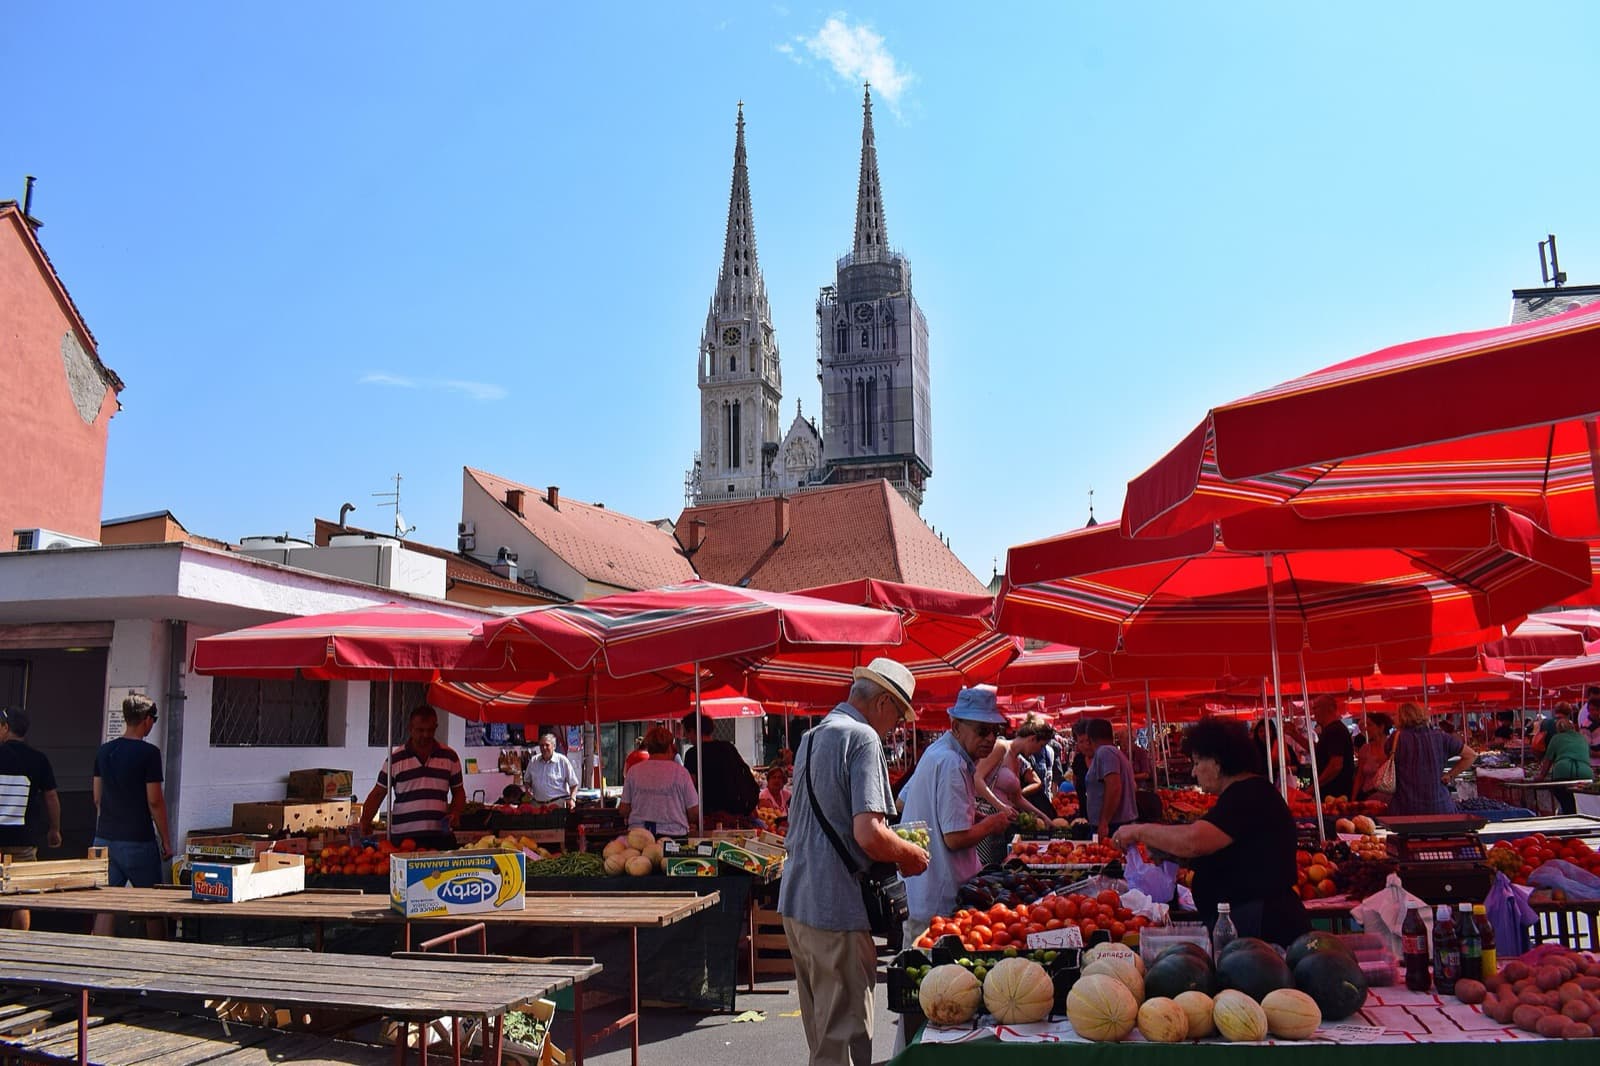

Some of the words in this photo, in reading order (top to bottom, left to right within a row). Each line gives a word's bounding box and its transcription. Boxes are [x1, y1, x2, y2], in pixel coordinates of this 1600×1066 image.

[408, 860, 450, 869] BANANAS
[452, 858, 492, 867] PREMIUM
[442, 882, 492, 902] derby
[420, 904, 447, 913] PRODUCE
